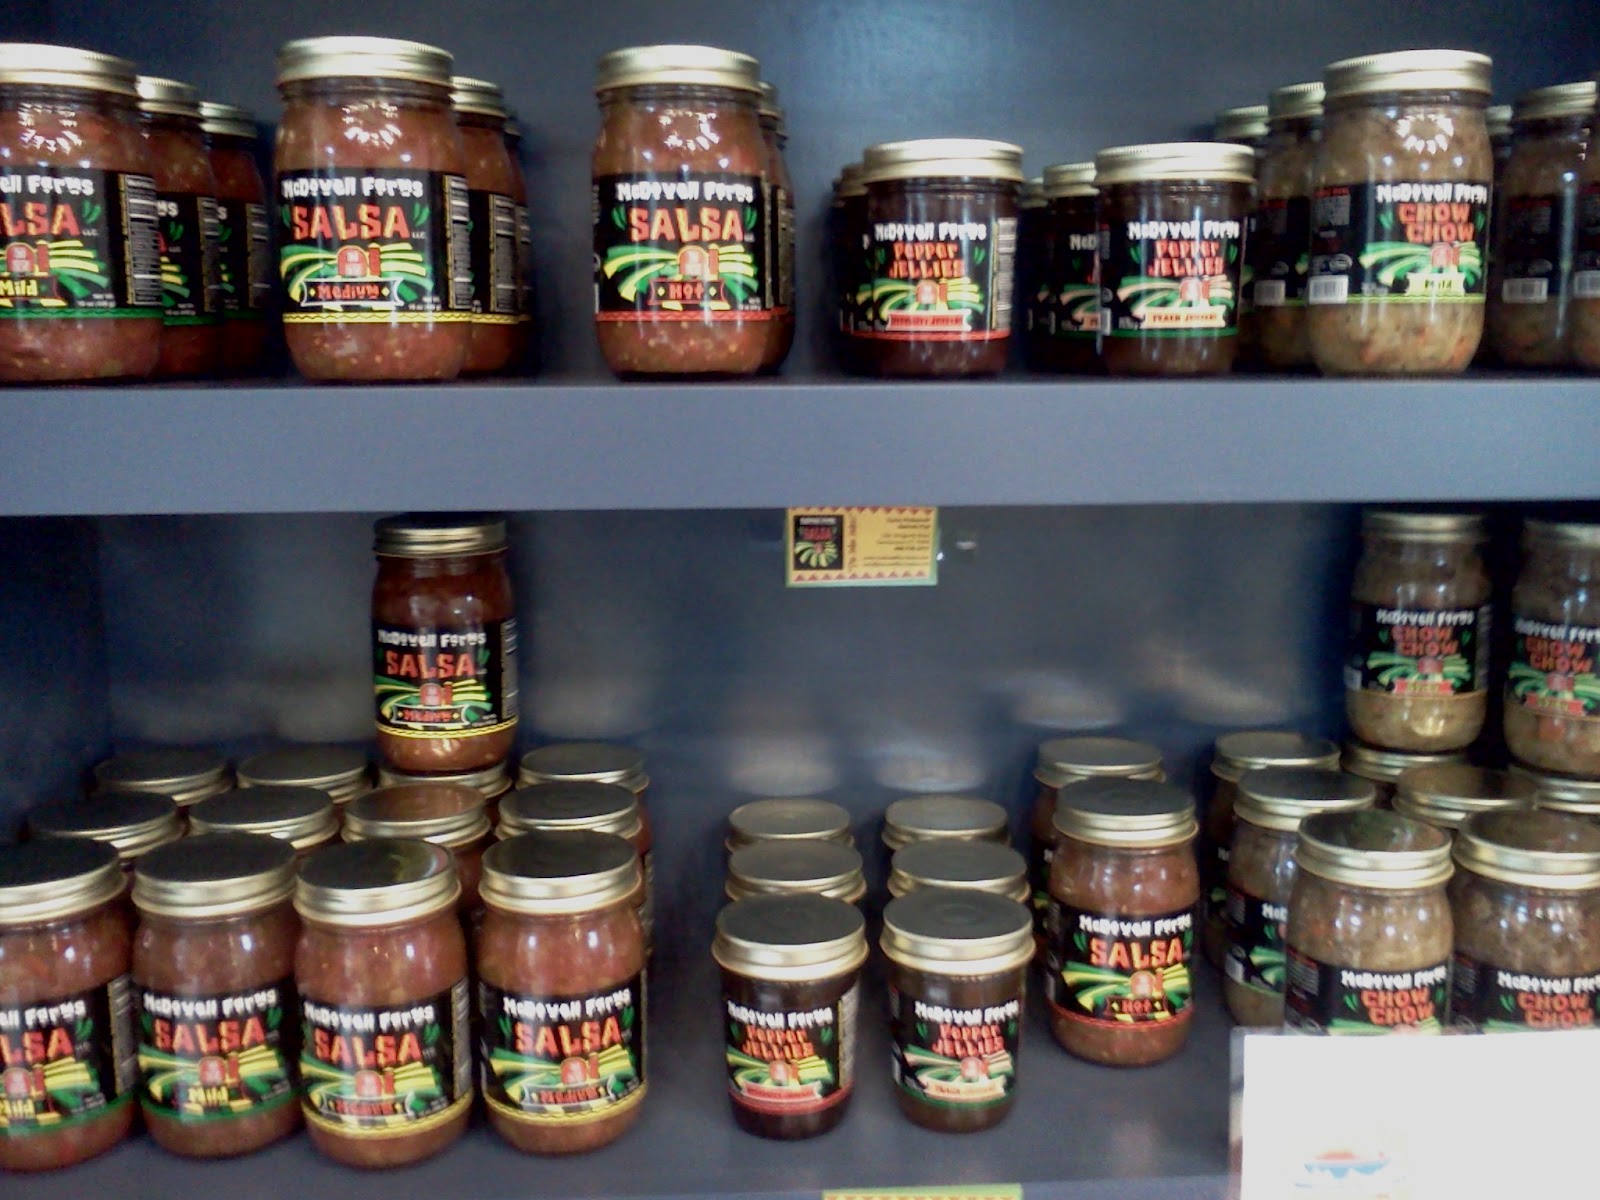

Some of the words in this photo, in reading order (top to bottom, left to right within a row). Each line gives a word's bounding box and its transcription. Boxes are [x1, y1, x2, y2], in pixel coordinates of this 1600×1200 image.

[0, 201, 80, 237] LSA
[290, 203, 411, 240] SALSA
[629, 206, 744, 242] SALSA
[1396, 202, 1470, 223] CHOW
[1406, 221, 1475, 243] CHOW
[316, 283, 380, 300] Medium
[386, 650, 476, 680] SALSA
[1090, 936, 1184, 970] SALSA
[0, 1027, 74, 1068] LSA
[154, 1016, 266, 1055] SALSA
[313, 1026, 422, 1068] SALSA
[515, 1015, 621, 1057] SALSA
